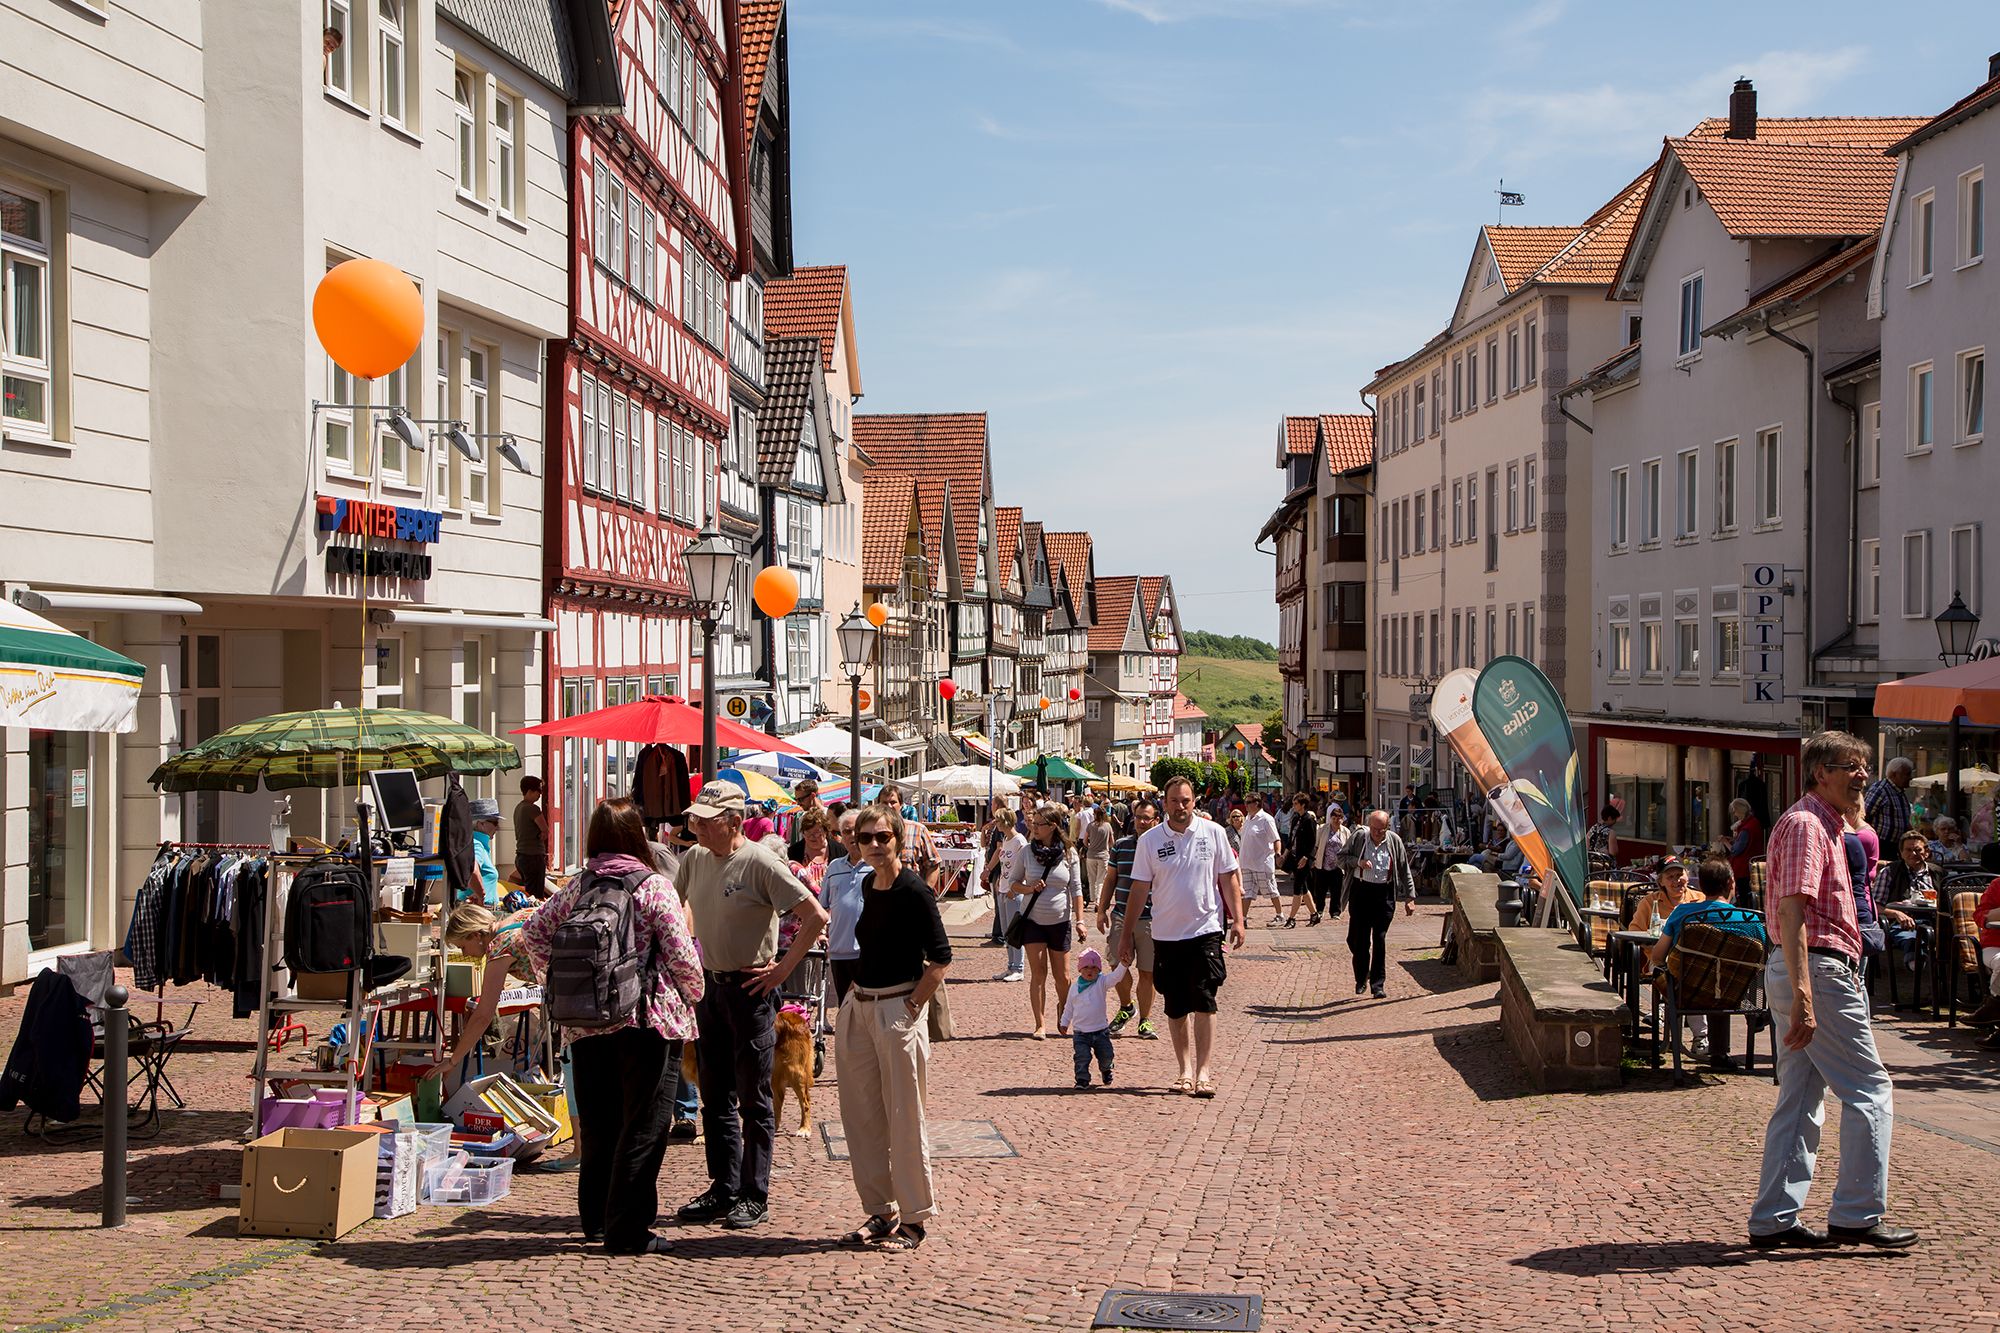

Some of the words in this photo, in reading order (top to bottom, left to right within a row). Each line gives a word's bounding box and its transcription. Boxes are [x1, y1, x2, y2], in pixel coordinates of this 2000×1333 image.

[347, 498, 443, 544] INTERSPORT
[1754, 566, 1775, 702] OPTIK
[38, 671, 55, 692] Bit
[731, 700, 742, 713] H
[1158, 846, 1176, 858] 52
[475, 1117, 492, 1126] DER
